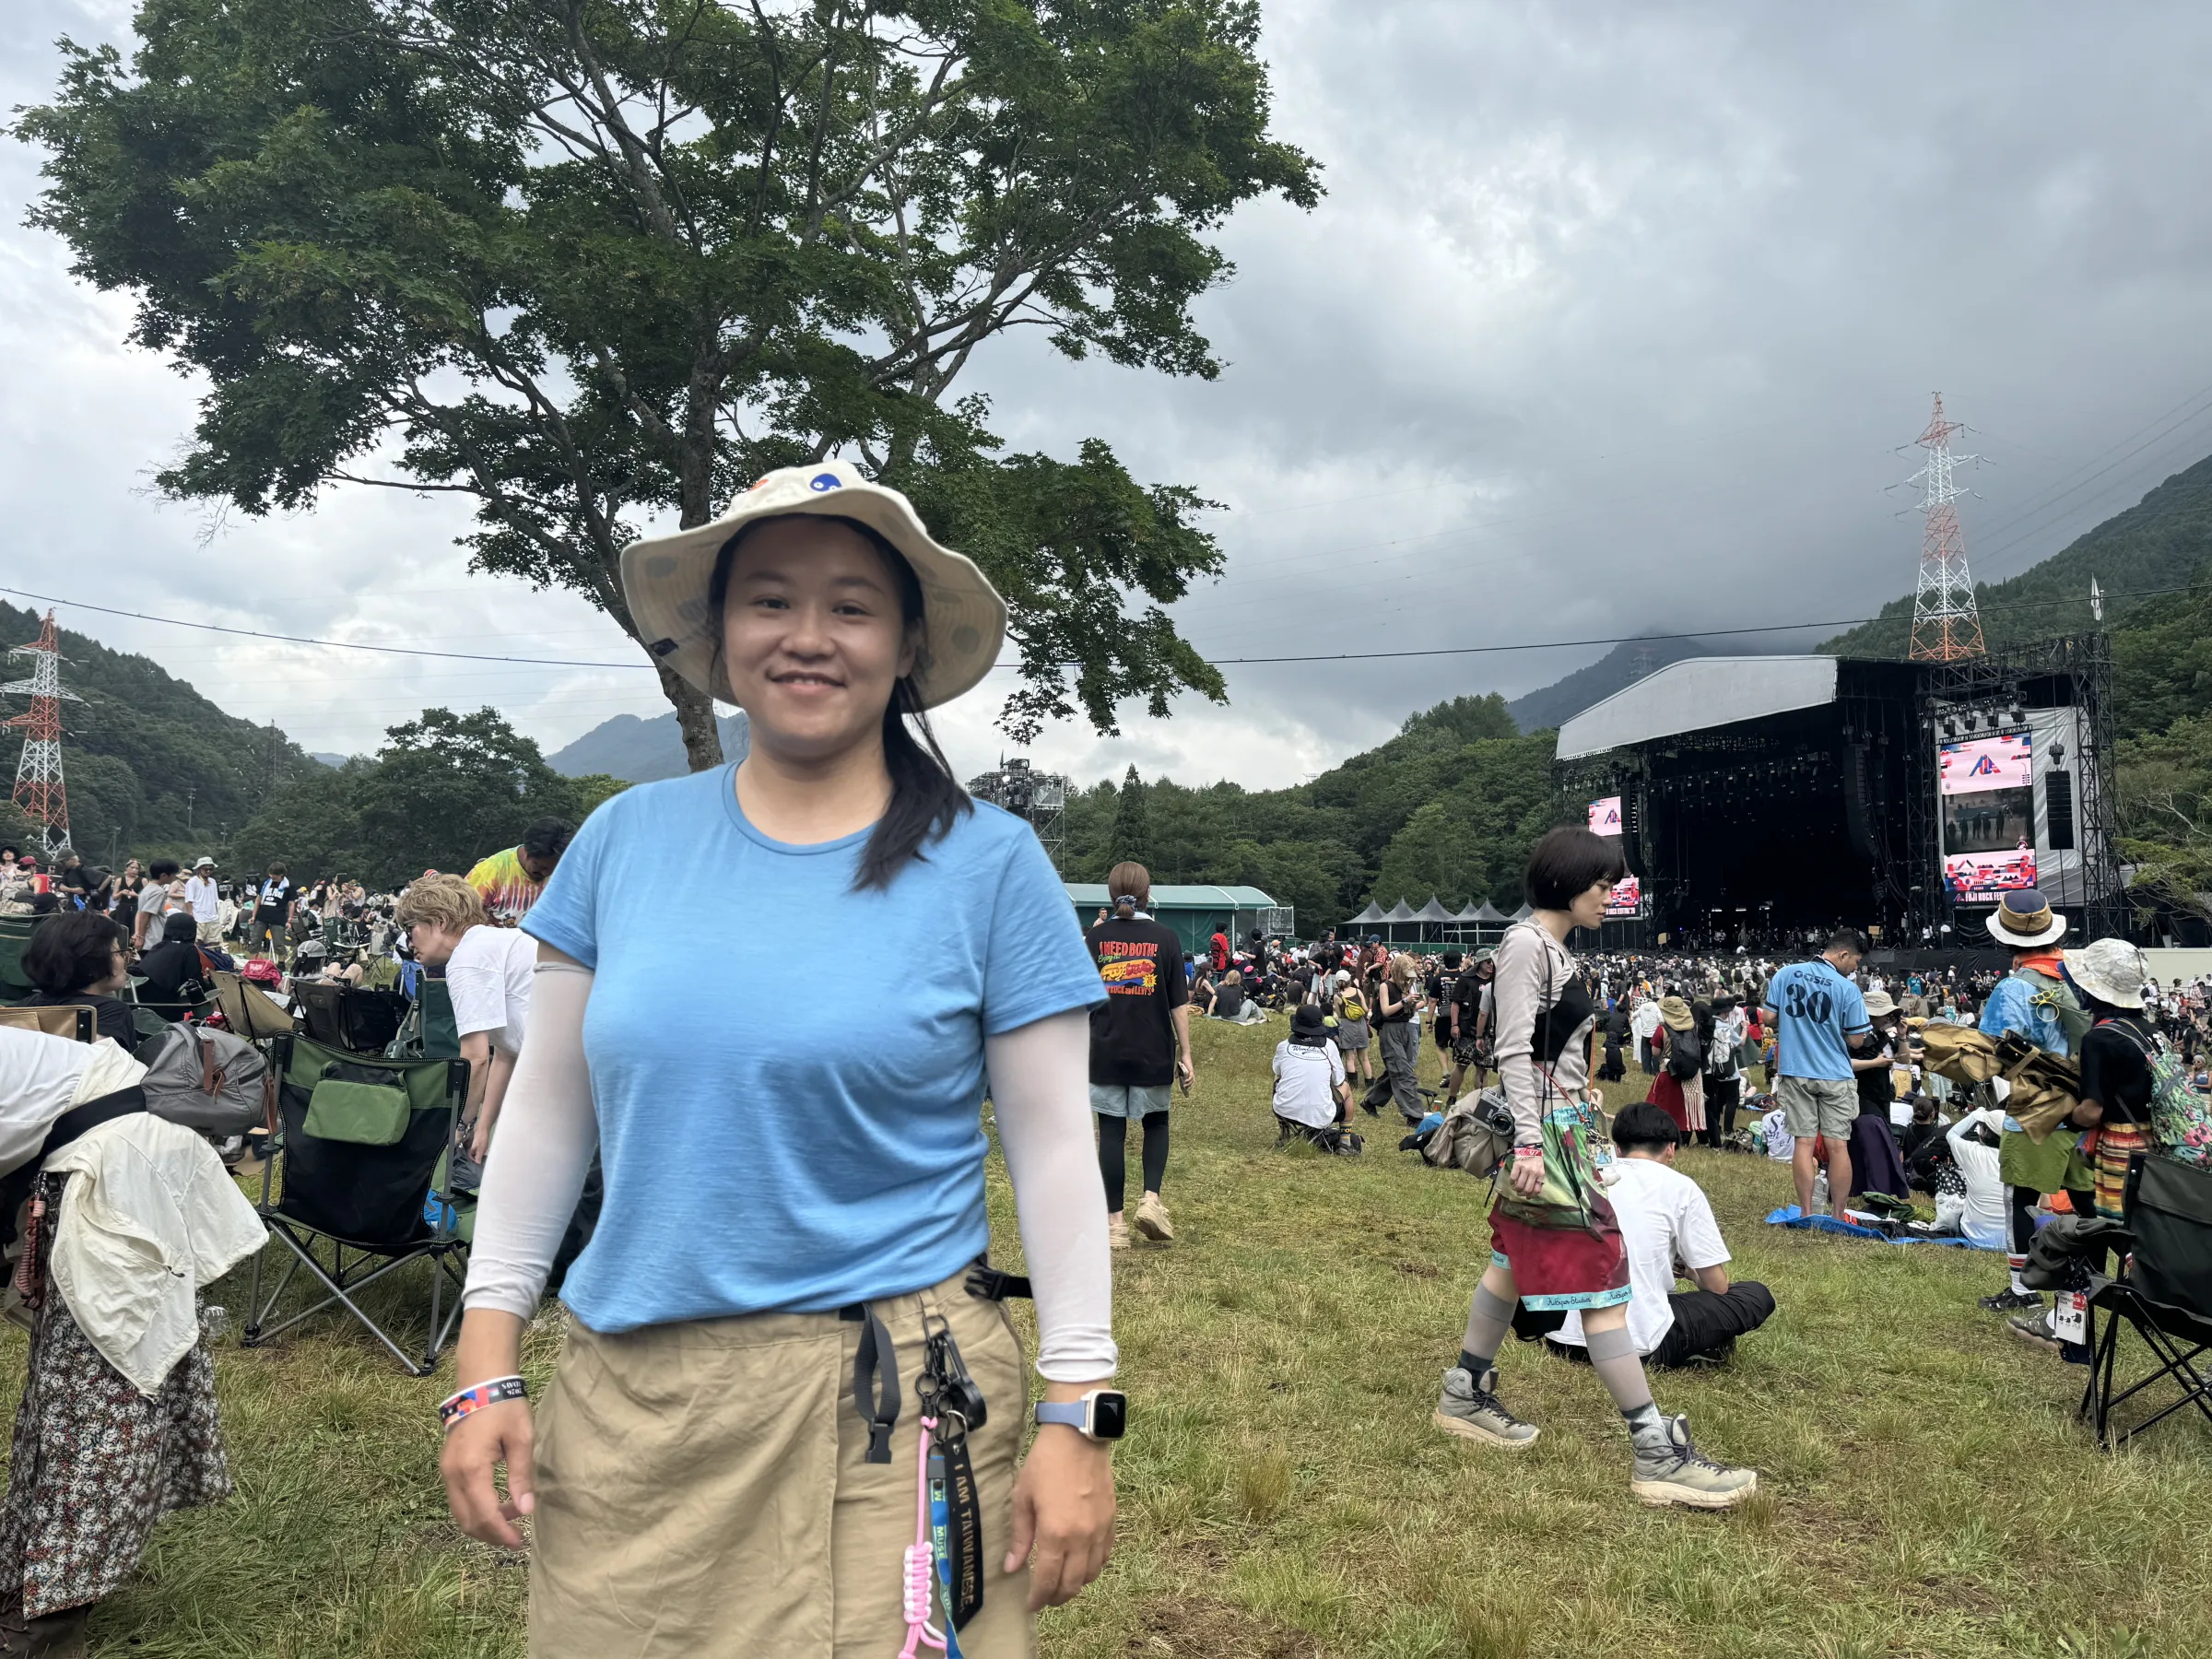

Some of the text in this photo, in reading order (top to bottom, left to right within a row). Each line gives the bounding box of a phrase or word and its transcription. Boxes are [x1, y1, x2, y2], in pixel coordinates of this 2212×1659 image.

[1965, 891, 1977, 902] FUJI
[1978, 891, 1993, 902] ROCK
[1100, 941, 1158, 957] I NEED BOTH!
[1794, 970, 1833, 987] oasis
[1785, 983, 1832, 1024] 30
[954, 1463, 963, 1471] I
[956, 1476, 971, 1504] AM
[936, 1526, 946, 1559] MUSE
